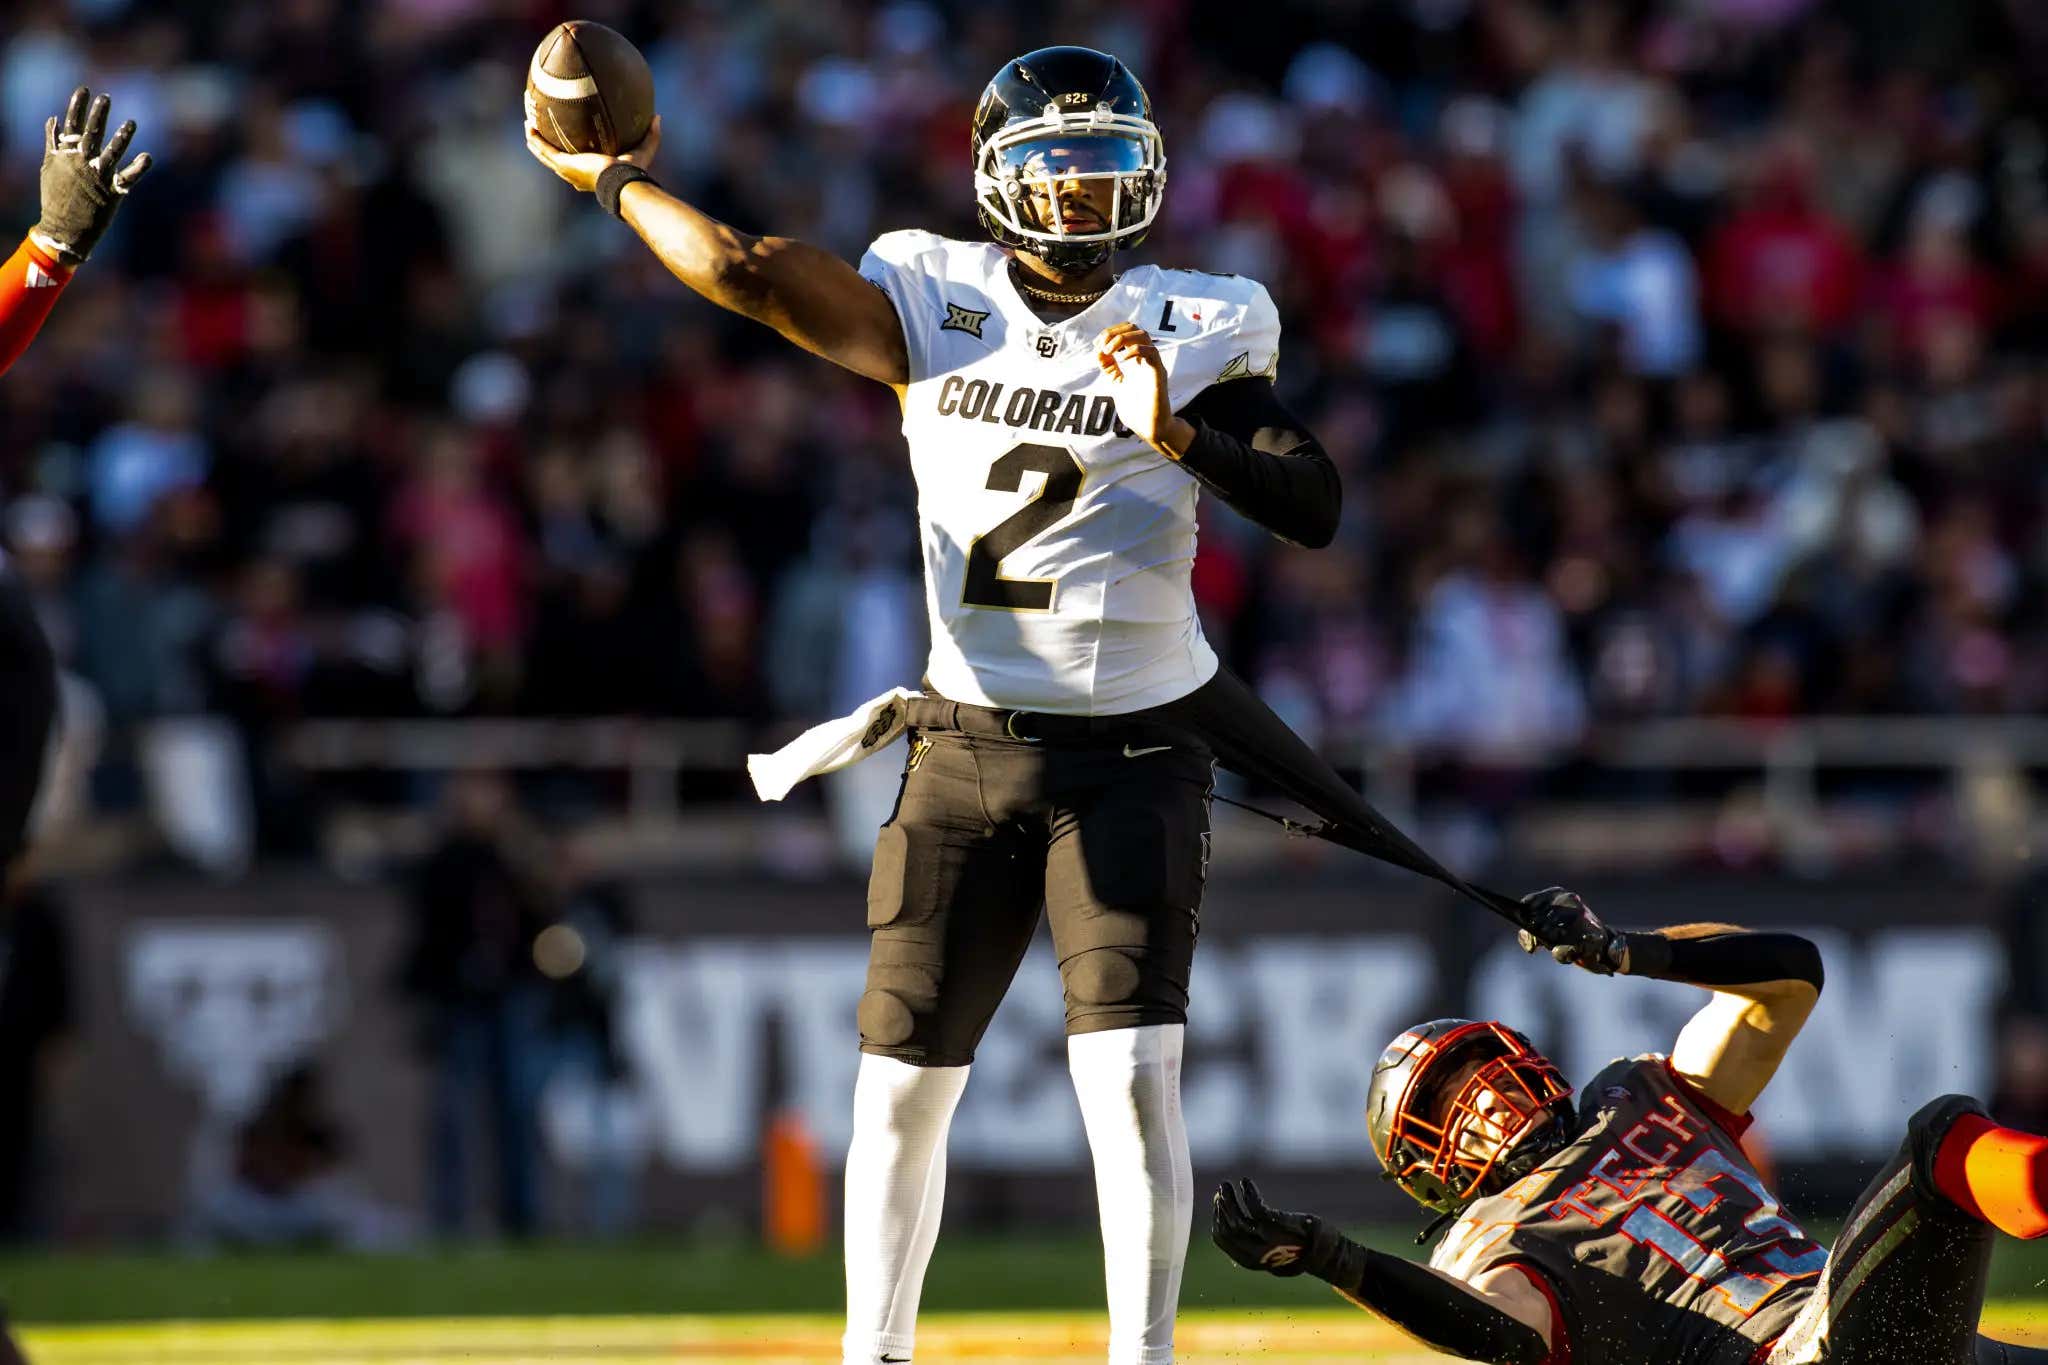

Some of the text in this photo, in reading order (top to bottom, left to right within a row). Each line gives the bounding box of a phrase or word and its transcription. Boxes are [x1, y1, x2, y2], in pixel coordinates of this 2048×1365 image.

[1158, 300, 1177, 332] L
[960, 442, 1087, 614] 2
[1545, 1093, 1711, 1226] TECH
[1617, 1147, 1833, 1318] 13
